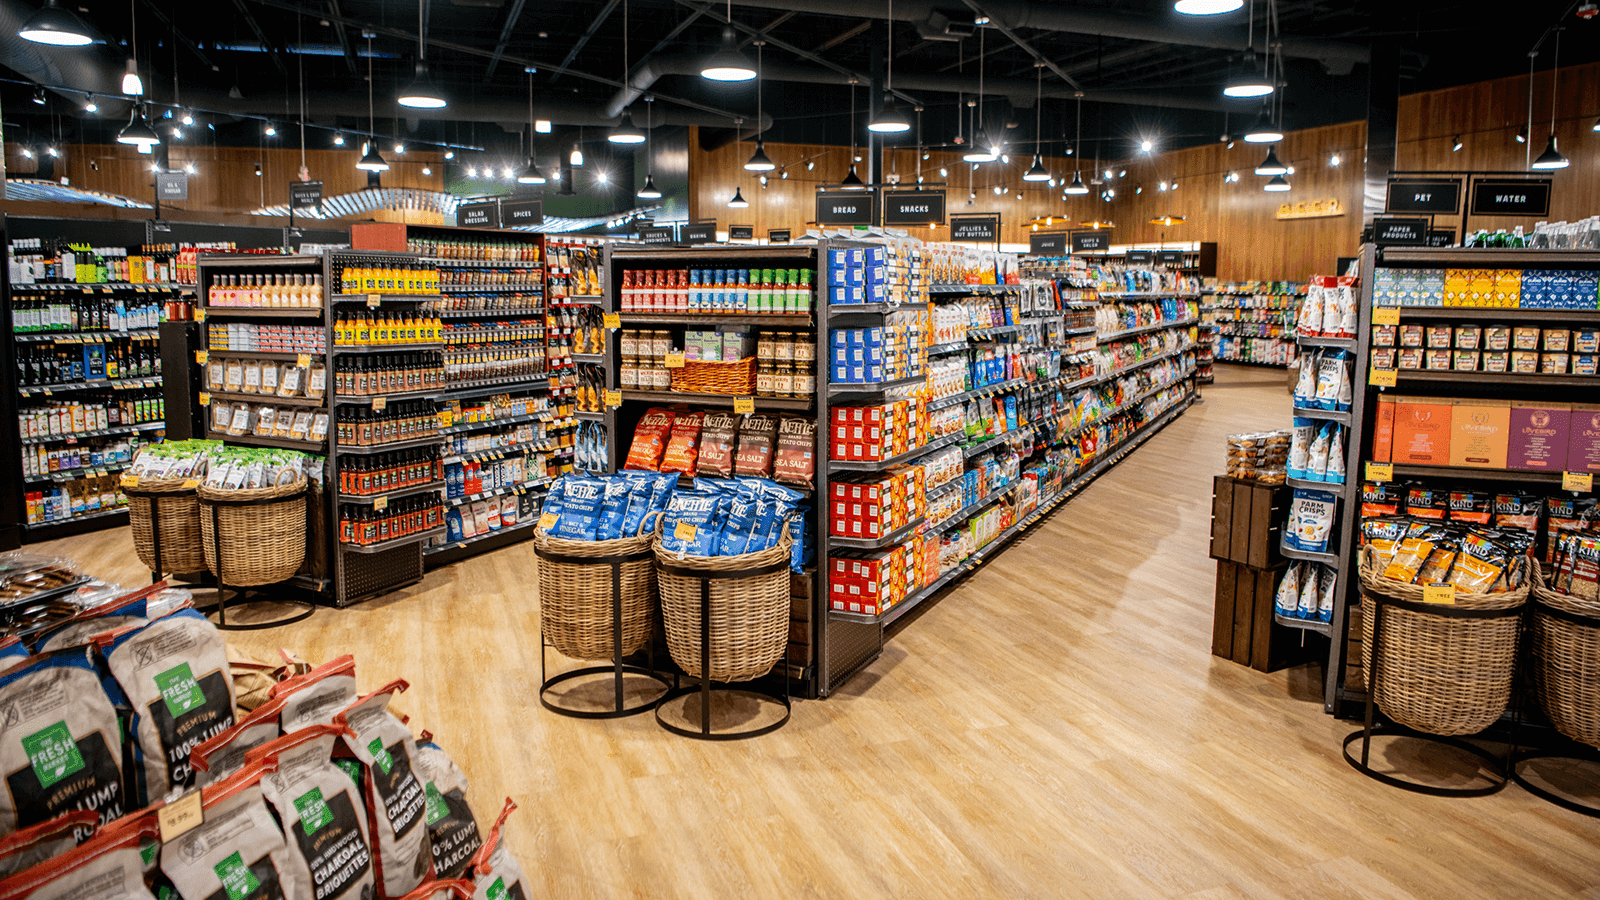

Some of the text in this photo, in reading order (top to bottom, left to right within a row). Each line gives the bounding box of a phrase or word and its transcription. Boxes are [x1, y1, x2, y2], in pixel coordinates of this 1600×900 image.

[1414, 194, 1432, 202] PET
[1496, 195, 1526, 203] WATER
[1280, 199, 1340, 216] BEER
[1522, 427, 1556, 436] LOVEBIRD
[708, 451, 724, 460] SALT
[746, 454, 764, 463] SALT
[776, 458, 808, 468] SEA SALT
[1363, 492, 1386, 500] KIND
[1408, 496, 1432, 505] KIND
[1301, 500, 1324, 508] PARM
[1450, 500, 1474, 508] KIND
[1496, 502, 1521, 512] KIND
[1299, 506, 1326, 516] CRISPS
[1550, 506, 1573, 515] KIND
[1463, 542, 1488, 556] KIND
[163, 678, 196, 700] FRESH
[176, 711, 216, 737] PREMIUM
[31, 738, 75, 768] FRESH
[169, 736, 201, 762] 100%
[46, 776, 96, 810] PREMIUM
[433, 837, 480, 876] HARCOAL
[314, 839, 364, 885] CHARCOAL
[316, 850, 369, 900] BRIQUETTES
